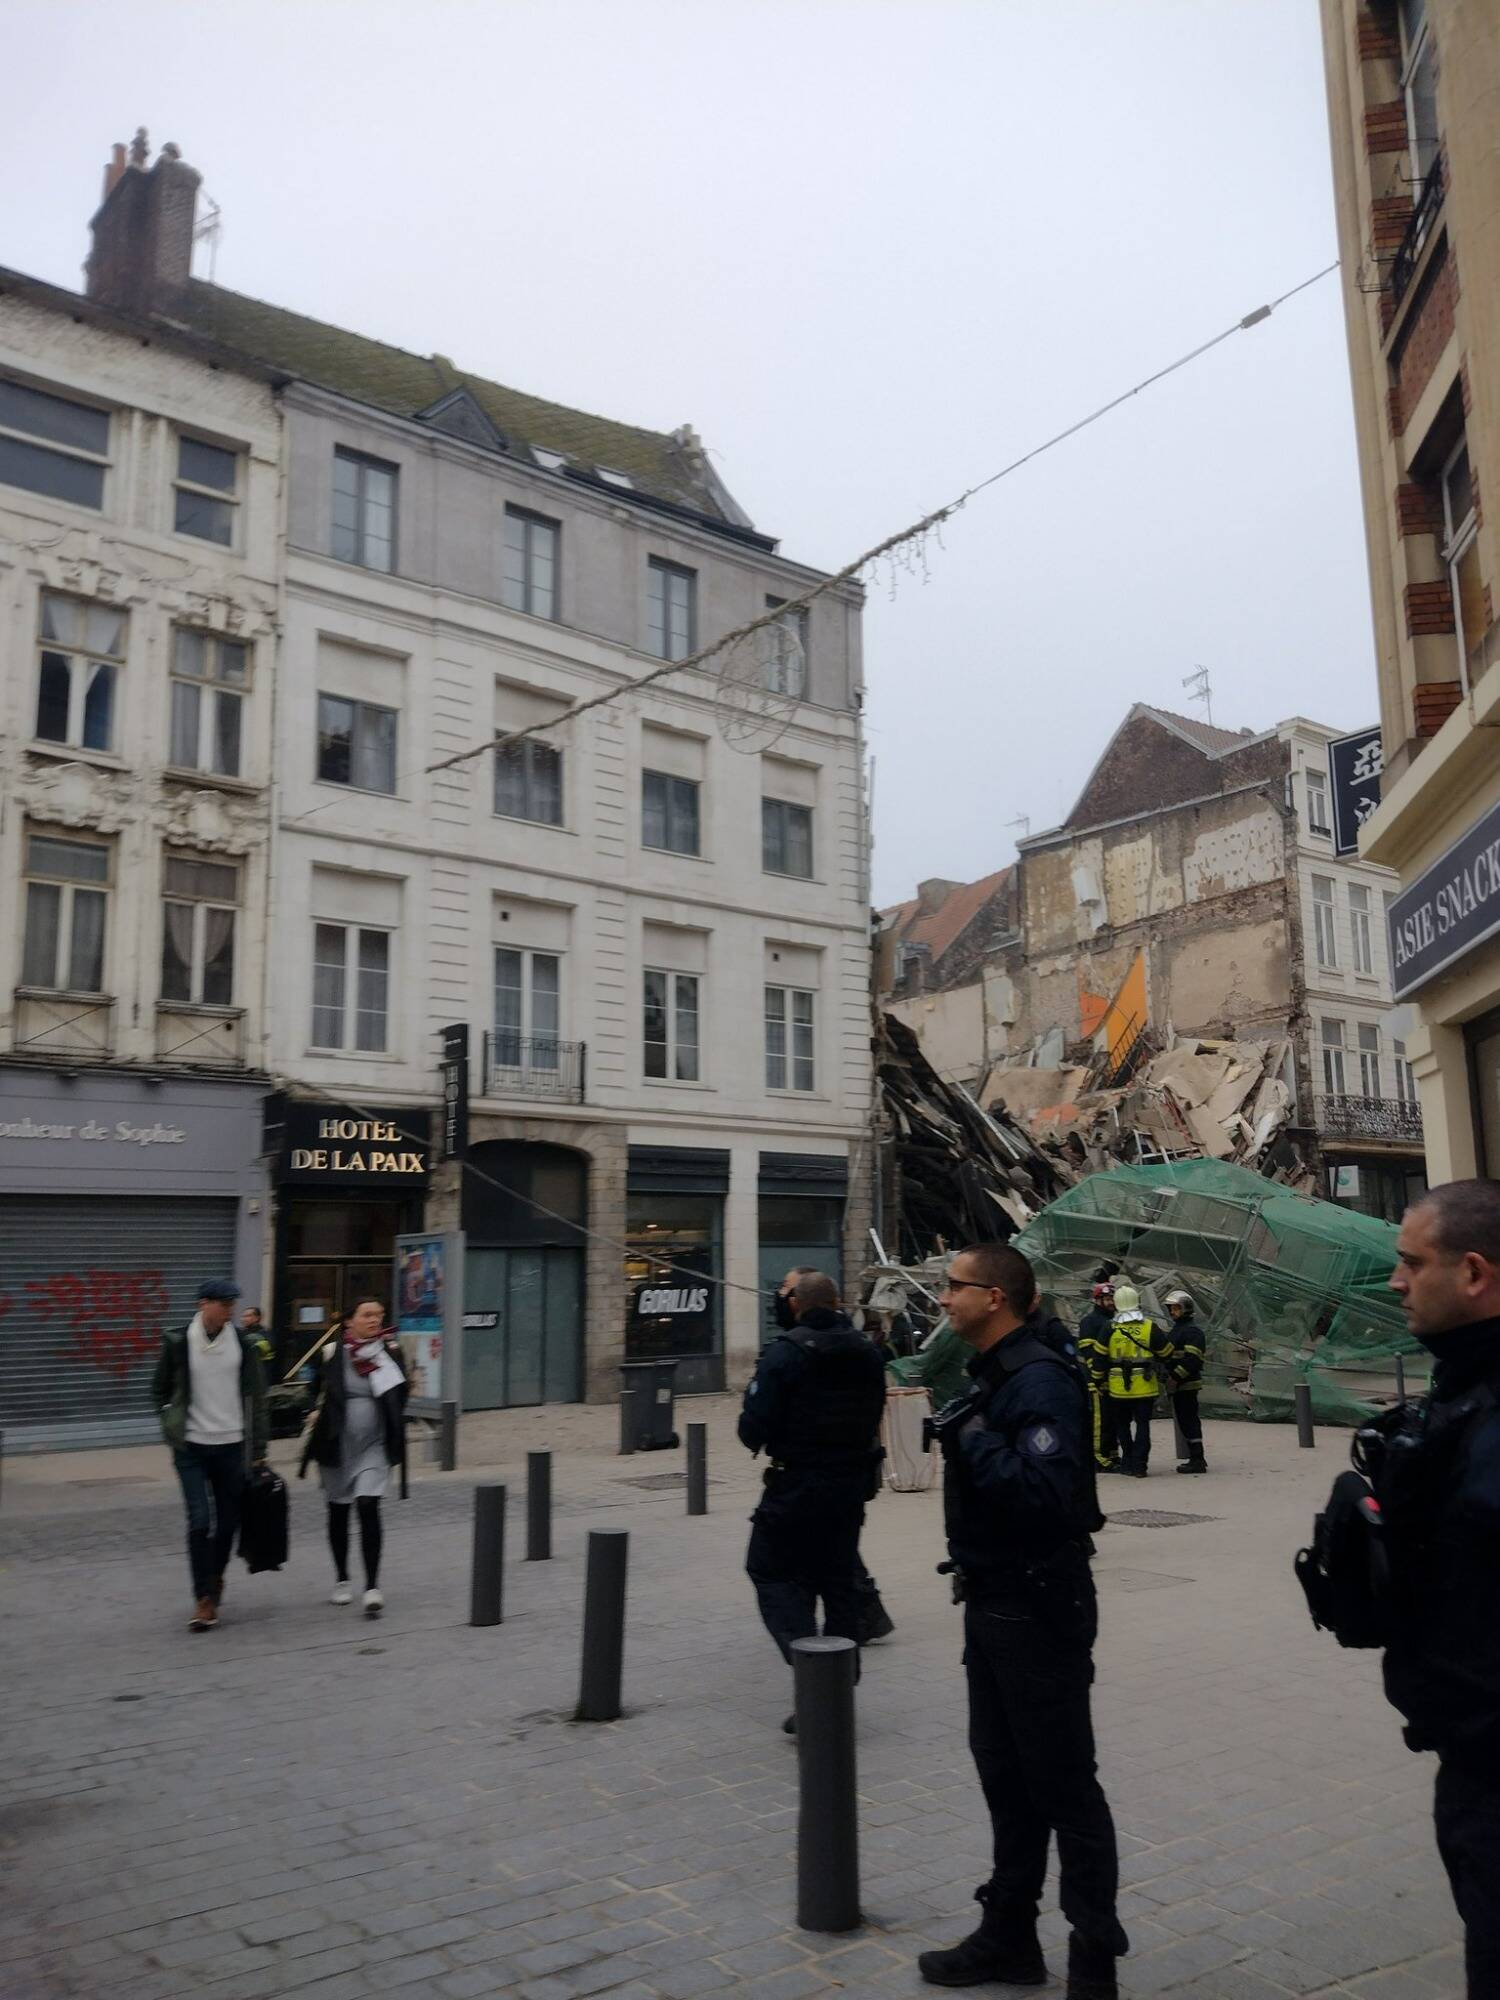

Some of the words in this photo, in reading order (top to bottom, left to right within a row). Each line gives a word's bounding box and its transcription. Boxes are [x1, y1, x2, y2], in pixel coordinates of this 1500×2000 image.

[1395, 901, 1436, 968] ASIE
[1436, 838, 1500, 936] SNACK
[445, 1065, 459, 1155] HOTEL
[79, 1120, 109, 1141] de
[114, 1121, 187, 1147] Sophie
[319, 1118, 402, 1141] HOTEL
[290, 1149, 328, 1169] DE
[331, 1150, 367, 1171] LA
[368, 1151, 425, 1173] PAIX
[638, 1288, 708, 1314] GORILLAS
